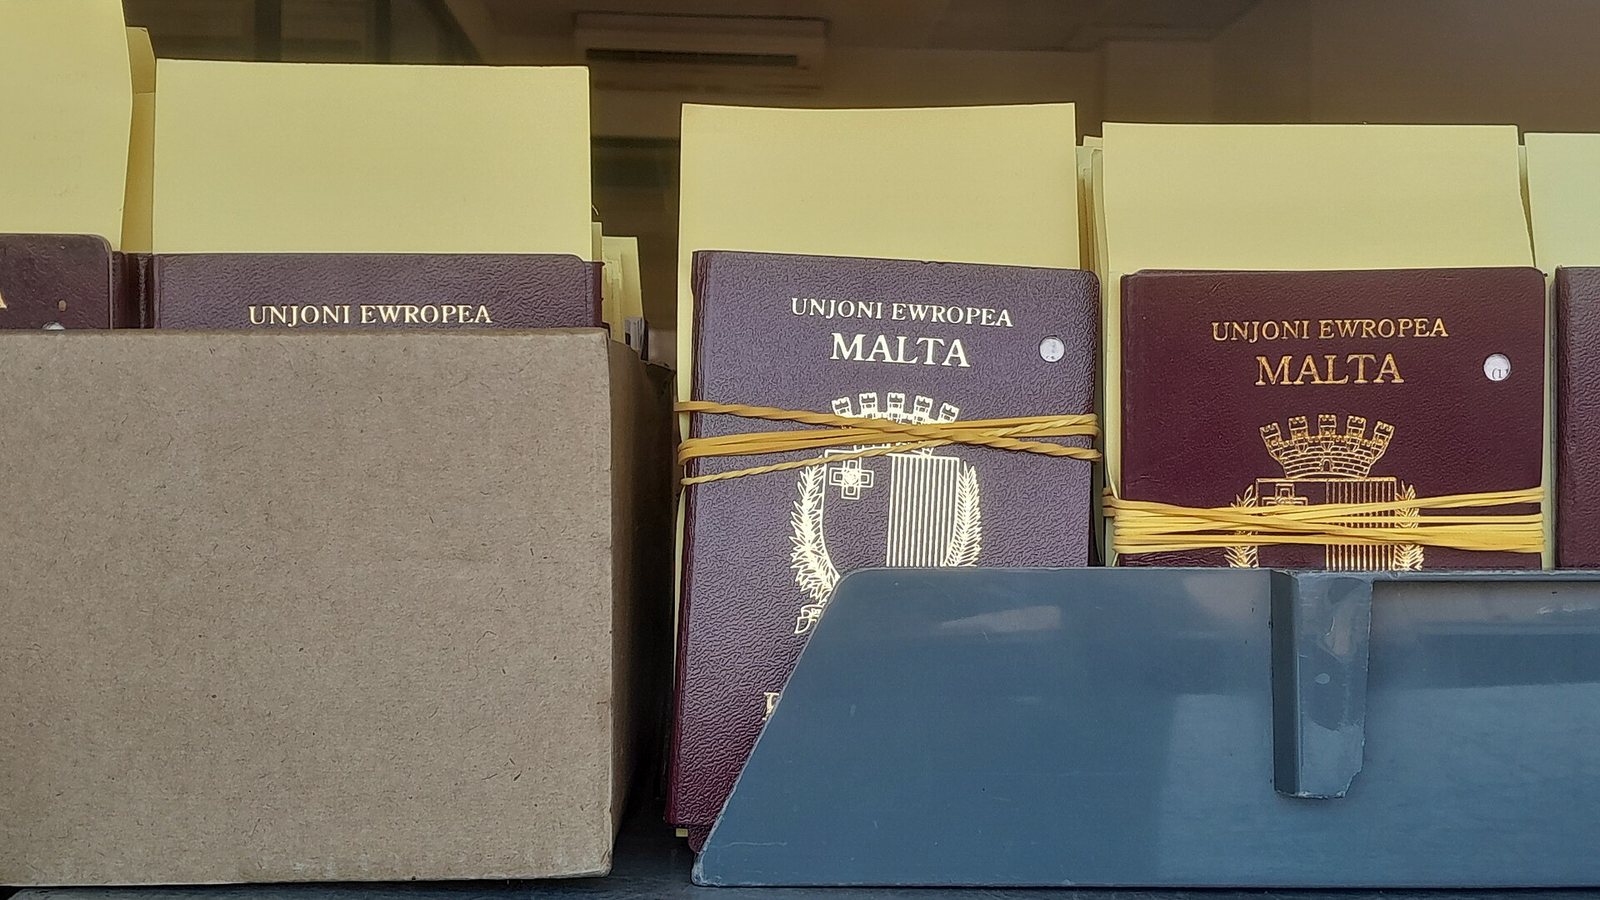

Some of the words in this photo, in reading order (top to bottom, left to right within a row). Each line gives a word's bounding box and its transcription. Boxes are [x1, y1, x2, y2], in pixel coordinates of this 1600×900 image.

[248, 304, 350, 328] UNJONI
[360, 304, 493, 324] EWROPEA
[791, 297, 883, 320] UNJONI
[891, 302, 1014, 328] EWROPEA
[1211, 319, 1310, 344] UNJONI
[1318, 317, 1449, 340] EWROPEA
[829, 332, 971, 368] MALTA
[1254, 352, 1405, 386] MALTA
